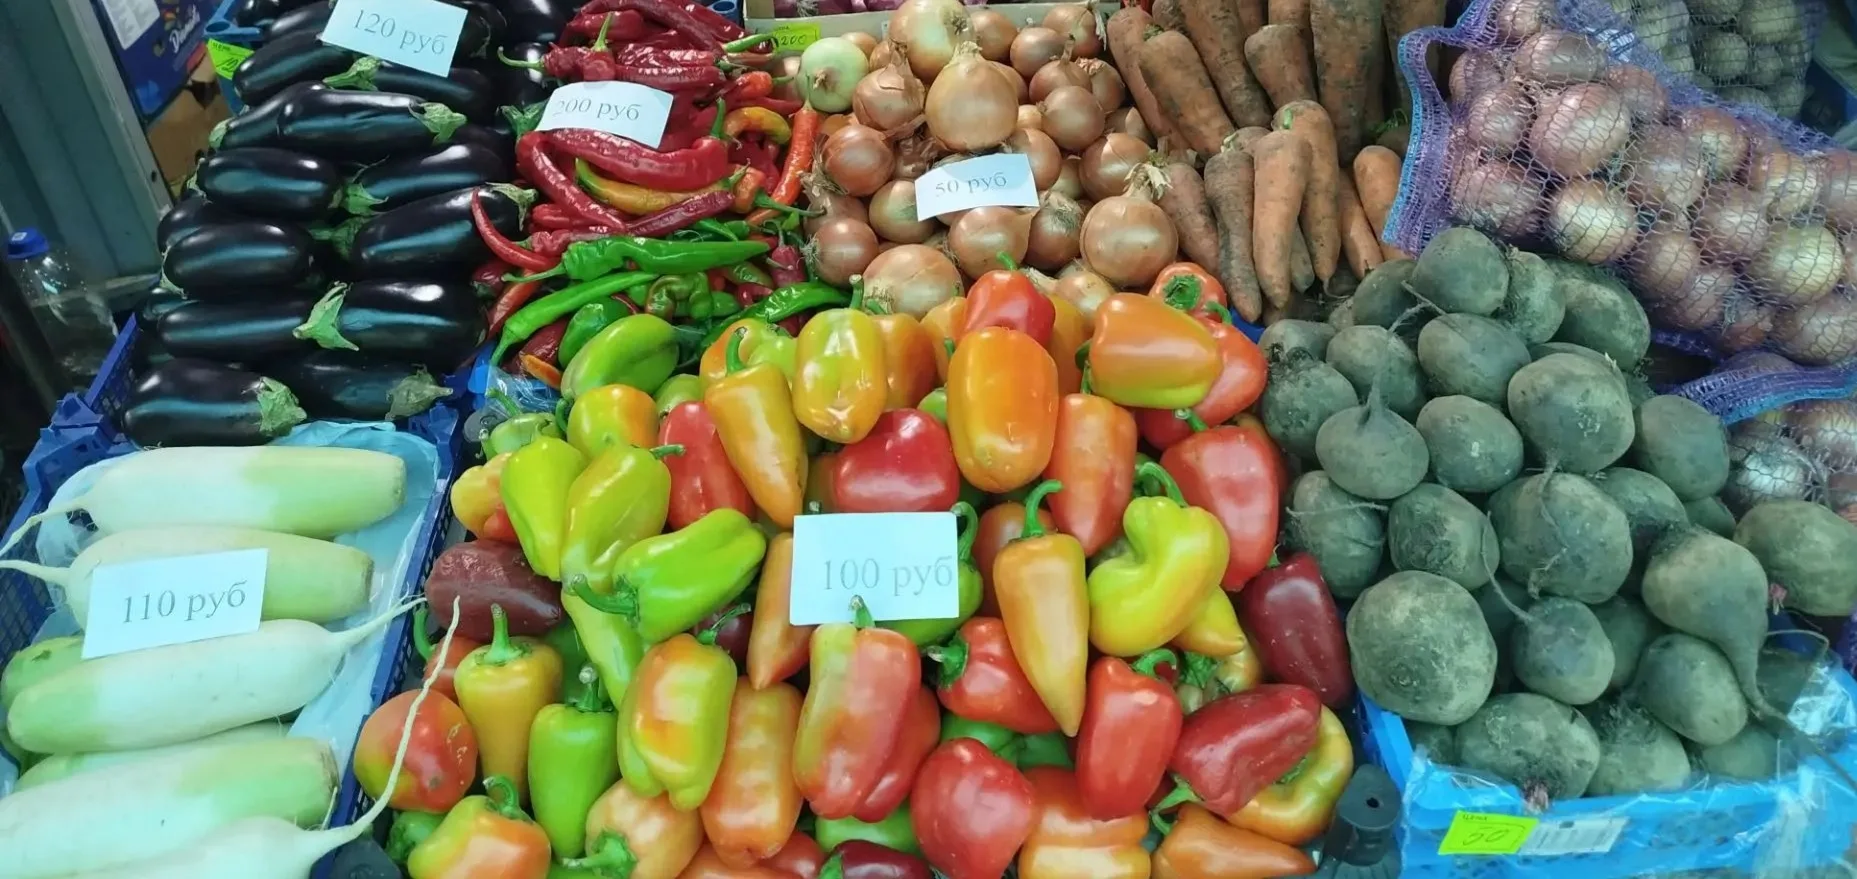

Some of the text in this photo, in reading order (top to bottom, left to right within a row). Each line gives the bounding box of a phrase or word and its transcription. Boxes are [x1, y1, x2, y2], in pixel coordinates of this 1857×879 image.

[353, 9, 448, 55] 120 руб
[552, 98, 642, 121] 200 руб
[935, 171, 1007, 197] 50 руб
[824, 555, 952, 597] 100 руб
[123, 579, 247, 623] 110 руб
